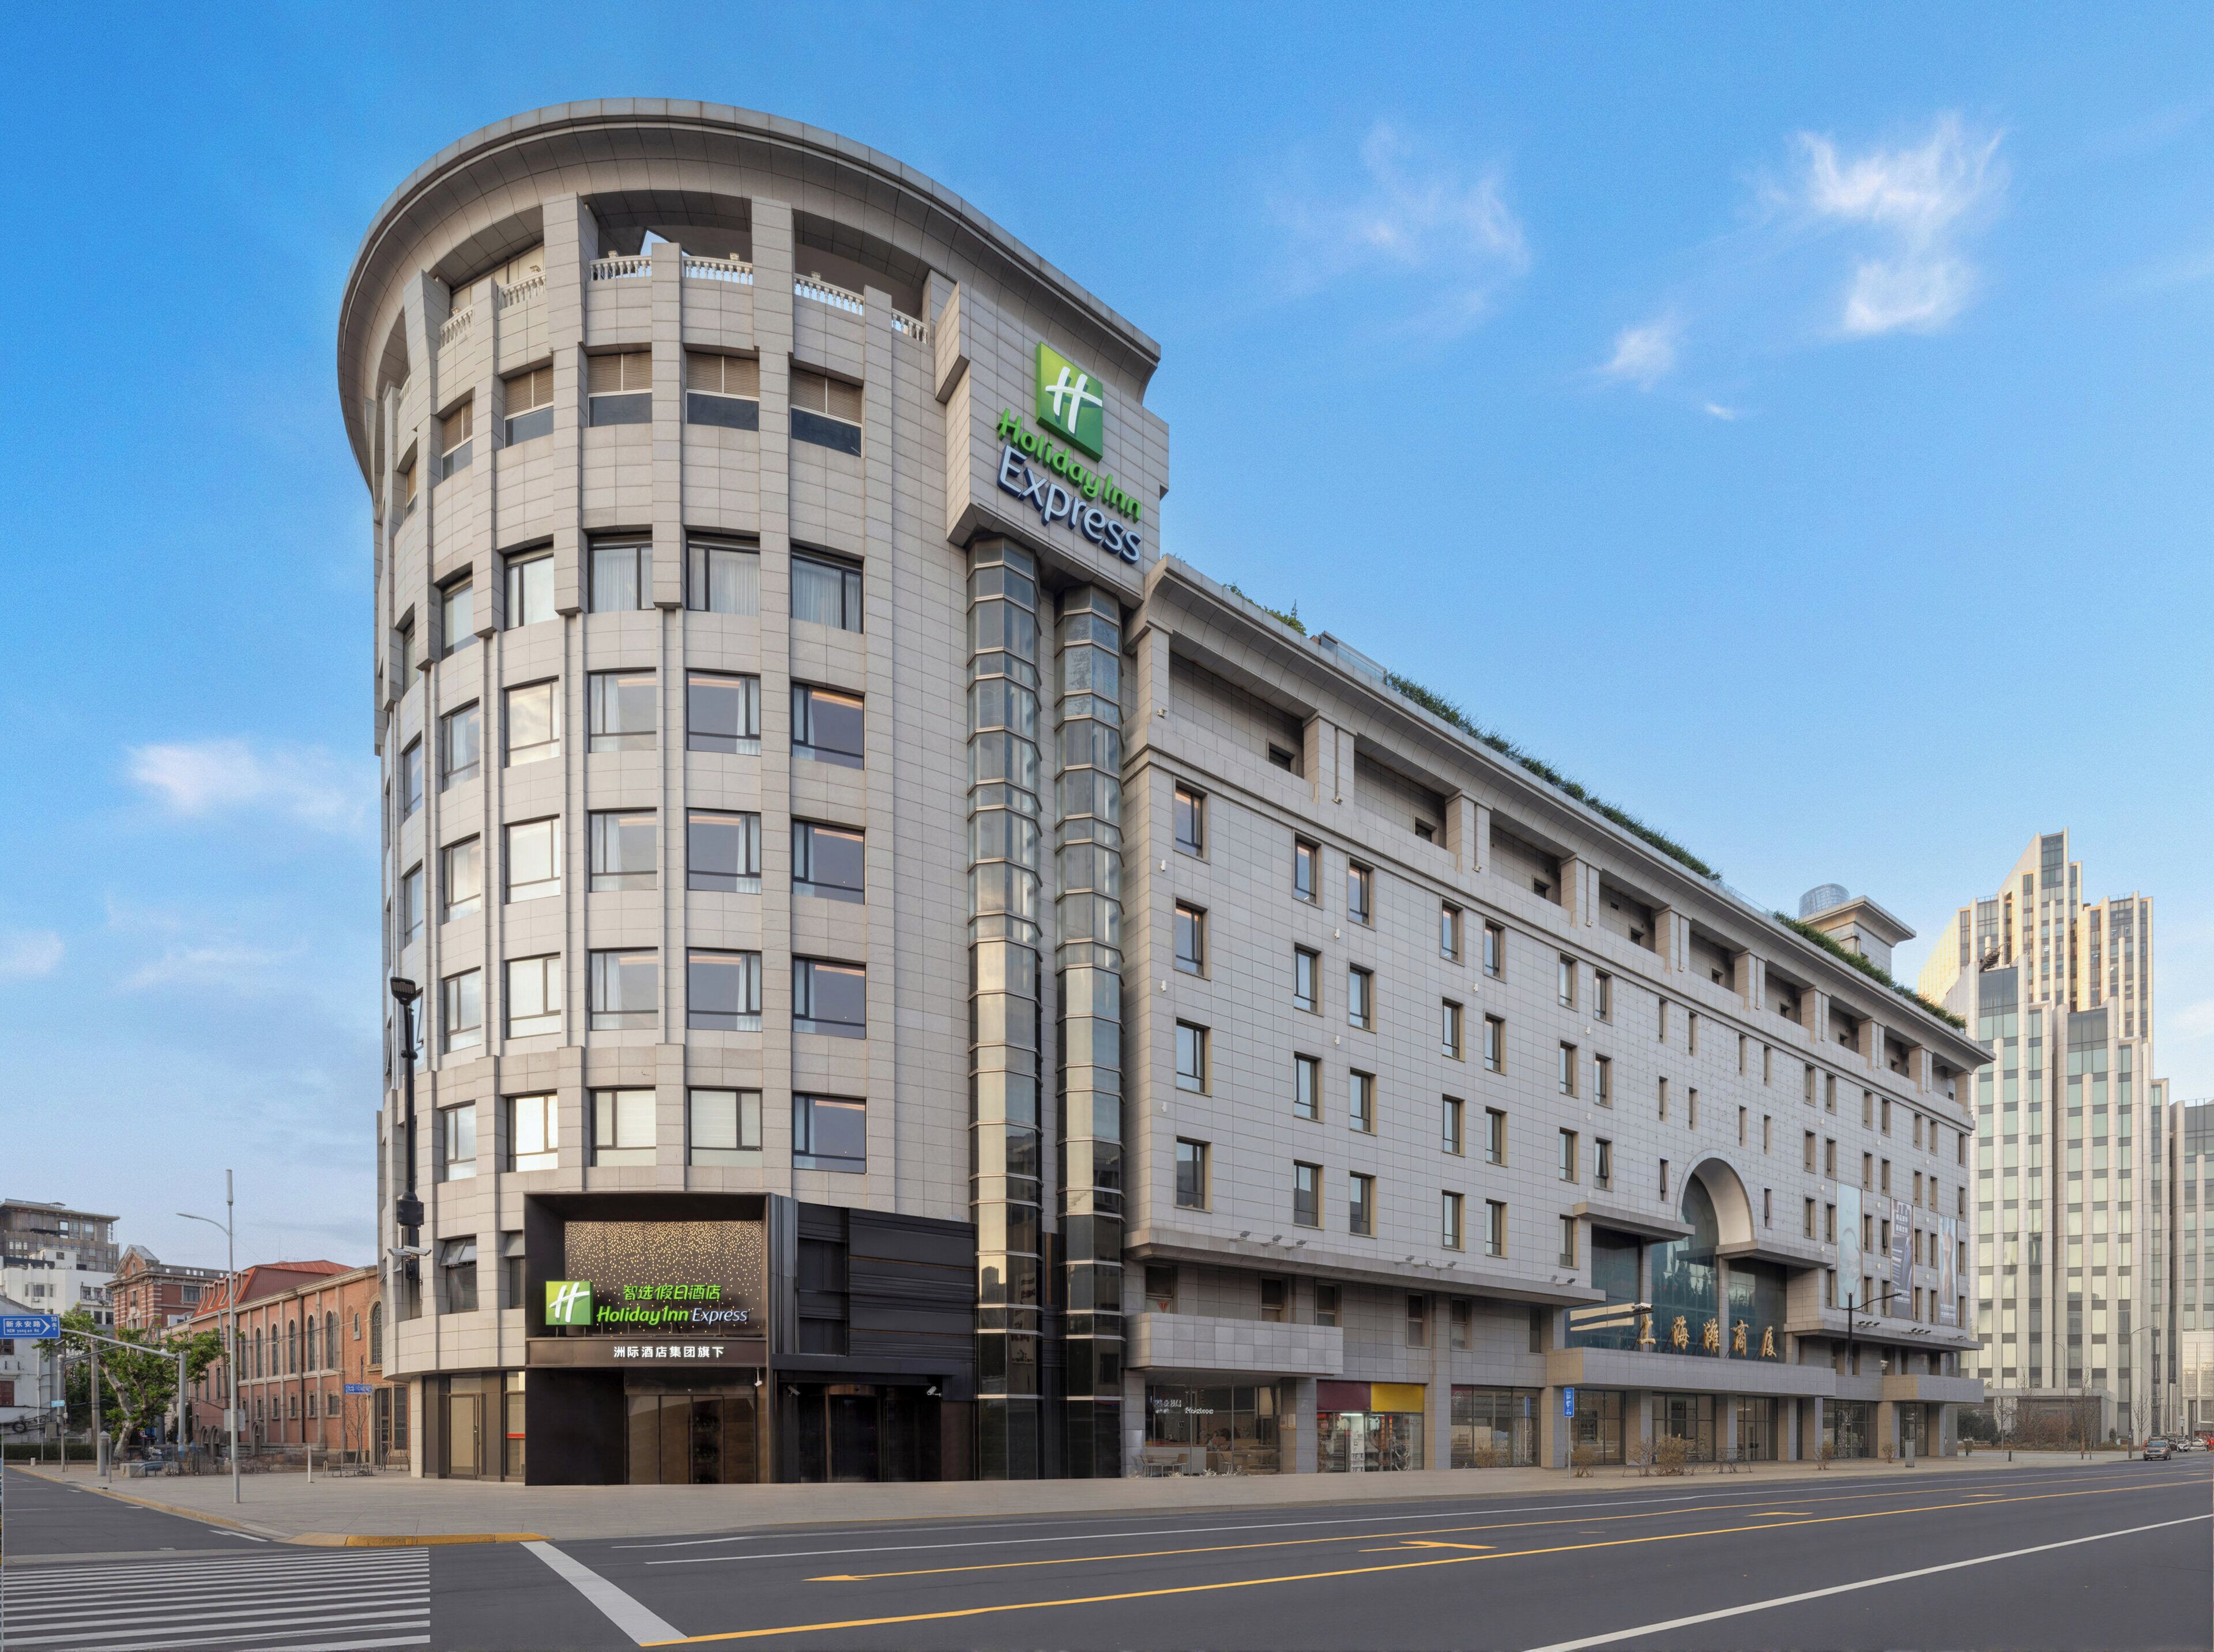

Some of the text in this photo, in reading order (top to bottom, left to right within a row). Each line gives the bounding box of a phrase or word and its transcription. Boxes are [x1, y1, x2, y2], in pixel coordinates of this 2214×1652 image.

[997, 408, 1142, 524] Holiday Inn
[997, 445, 1142, 565] Express
[623, 1285, 721, 1300] 智选假日酒店
[597, 1305, 748, 1325] Holiday Inn Express
[613, 1346, 724, 1359] 洲际酒店集团旗下
